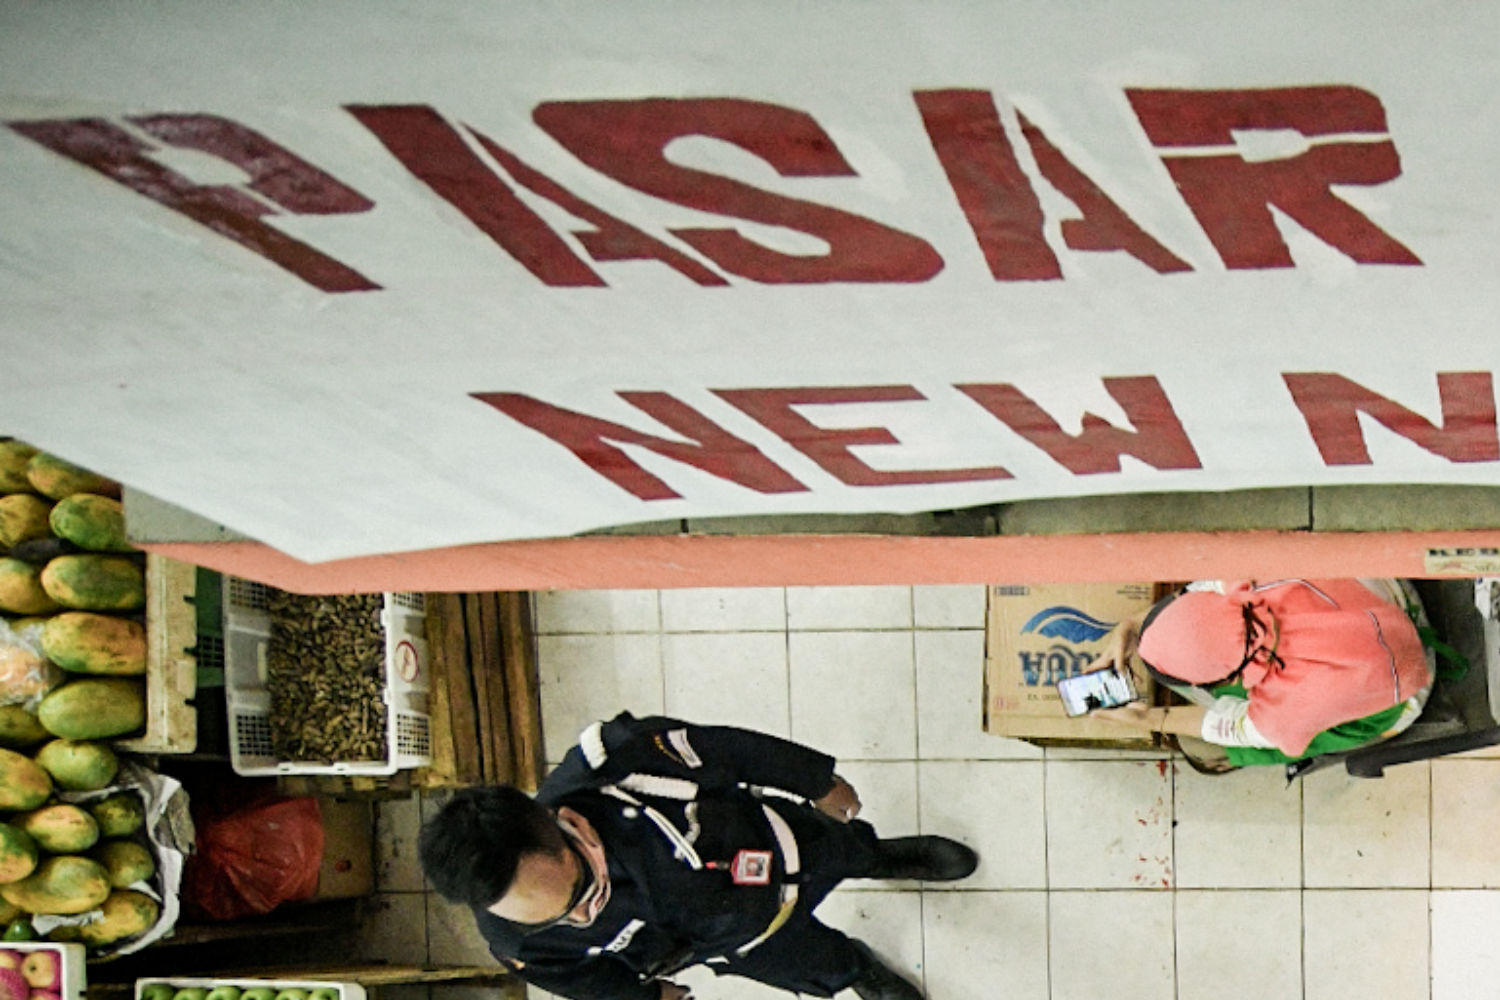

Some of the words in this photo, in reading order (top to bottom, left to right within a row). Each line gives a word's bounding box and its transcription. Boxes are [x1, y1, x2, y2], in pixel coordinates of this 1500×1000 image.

[2, 86, 1424, 293] PASAR
[467, 374, 1205, 501] NEW
[1018, 644, 1102, 687] QUA
